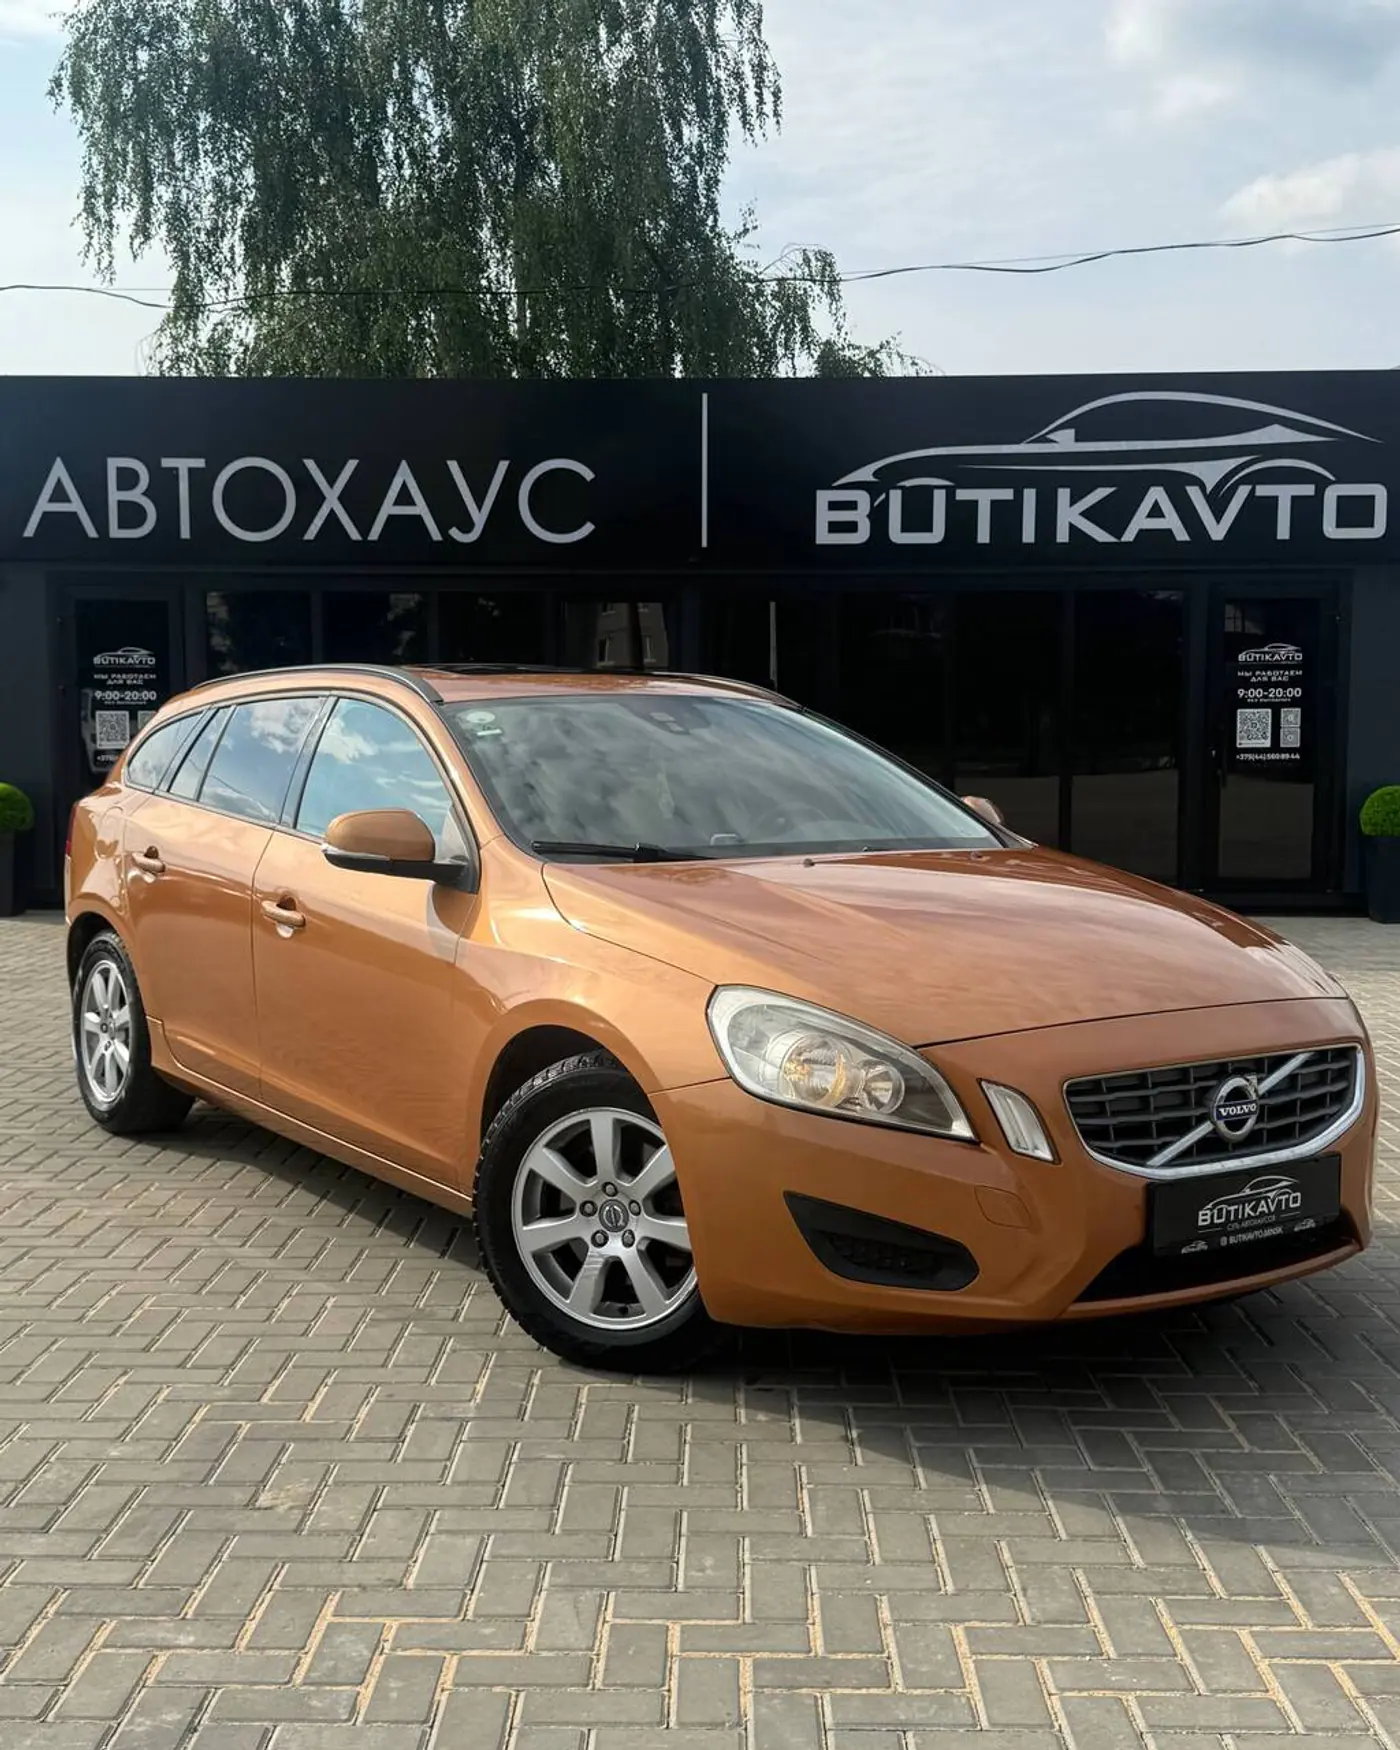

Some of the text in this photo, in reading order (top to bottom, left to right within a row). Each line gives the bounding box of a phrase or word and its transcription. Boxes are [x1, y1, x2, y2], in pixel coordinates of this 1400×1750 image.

[23, 457, 595, 544] АВТОХАУС
[815, 483, 1388, 544] BUTIKAVTO
[93, 656, 157, 665] BUTIKAVTO
[1238, 653, 1303, 662] BUTIKAVTO
[94, 690, 157, 701] 9:00-20:00
[1237, 687, 1302, 698] 9:00-20:00
[1219, 1103, 1257, 1117] VOLVO
[1197, 1192, 1302, 1227] BUTIKAVTO
